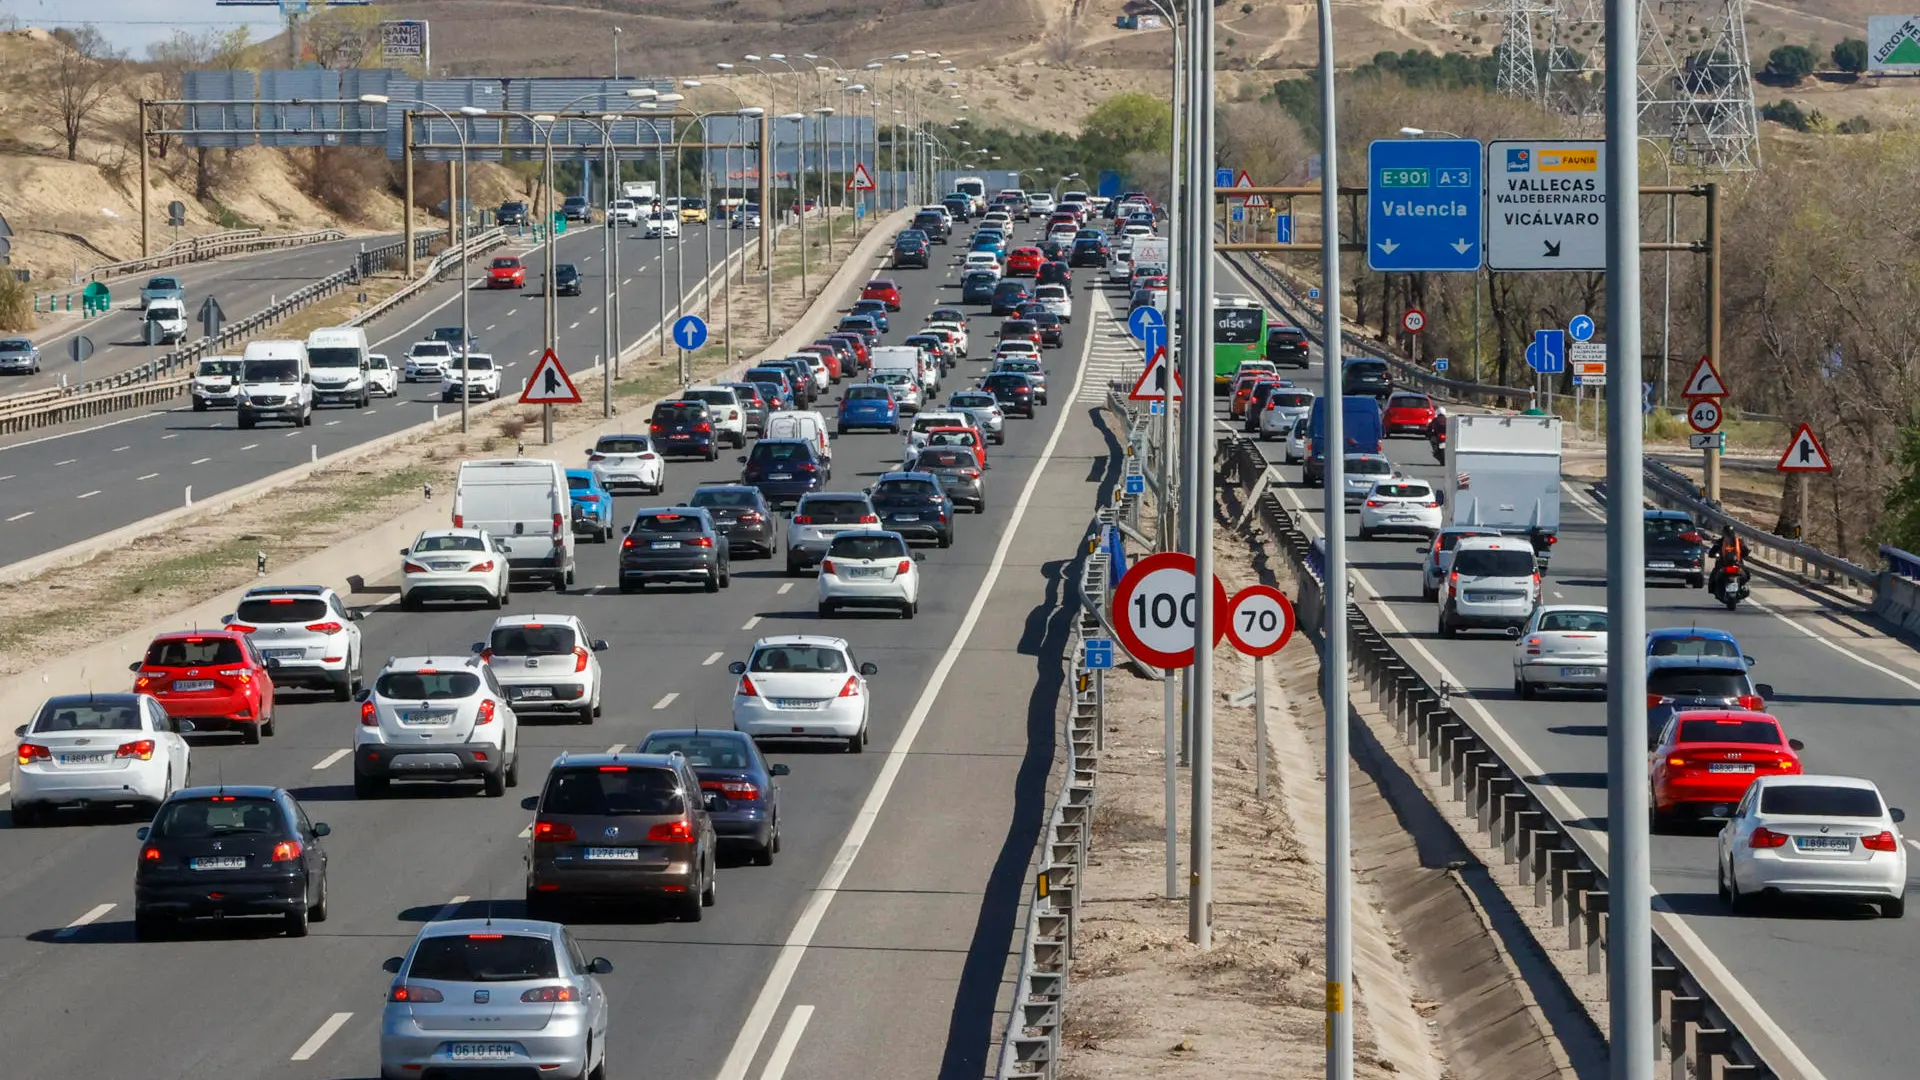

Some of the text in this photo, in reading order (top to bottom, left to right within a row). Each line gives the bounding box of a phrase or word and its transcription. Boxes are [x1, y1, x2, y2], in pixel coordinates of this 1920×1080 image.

[1873, 28, 1905, 63] LEROY
[1562, 156, 1596, 164] FAUNIA
[1383, 171, 1468, 184] E-901 A-3
[1508, 179, 1596, 191] VALLECAS
[1496, 194, 1606, 204] VALDEBERNARDO
[1382, 200, 1467, 217] Valencia
[1504, 209, 1599, 226] VICÁLVARO
[1218, 318, 1245, 329] alsa
[1408, 317, 1420, 325] 70
[1694, 409, 1715, 421] 40
[1241, 610, 1277, 632] 70
[1095, 653, 1102, 664] 5
[455, 1044, 511, 1056] 0610 FRM
